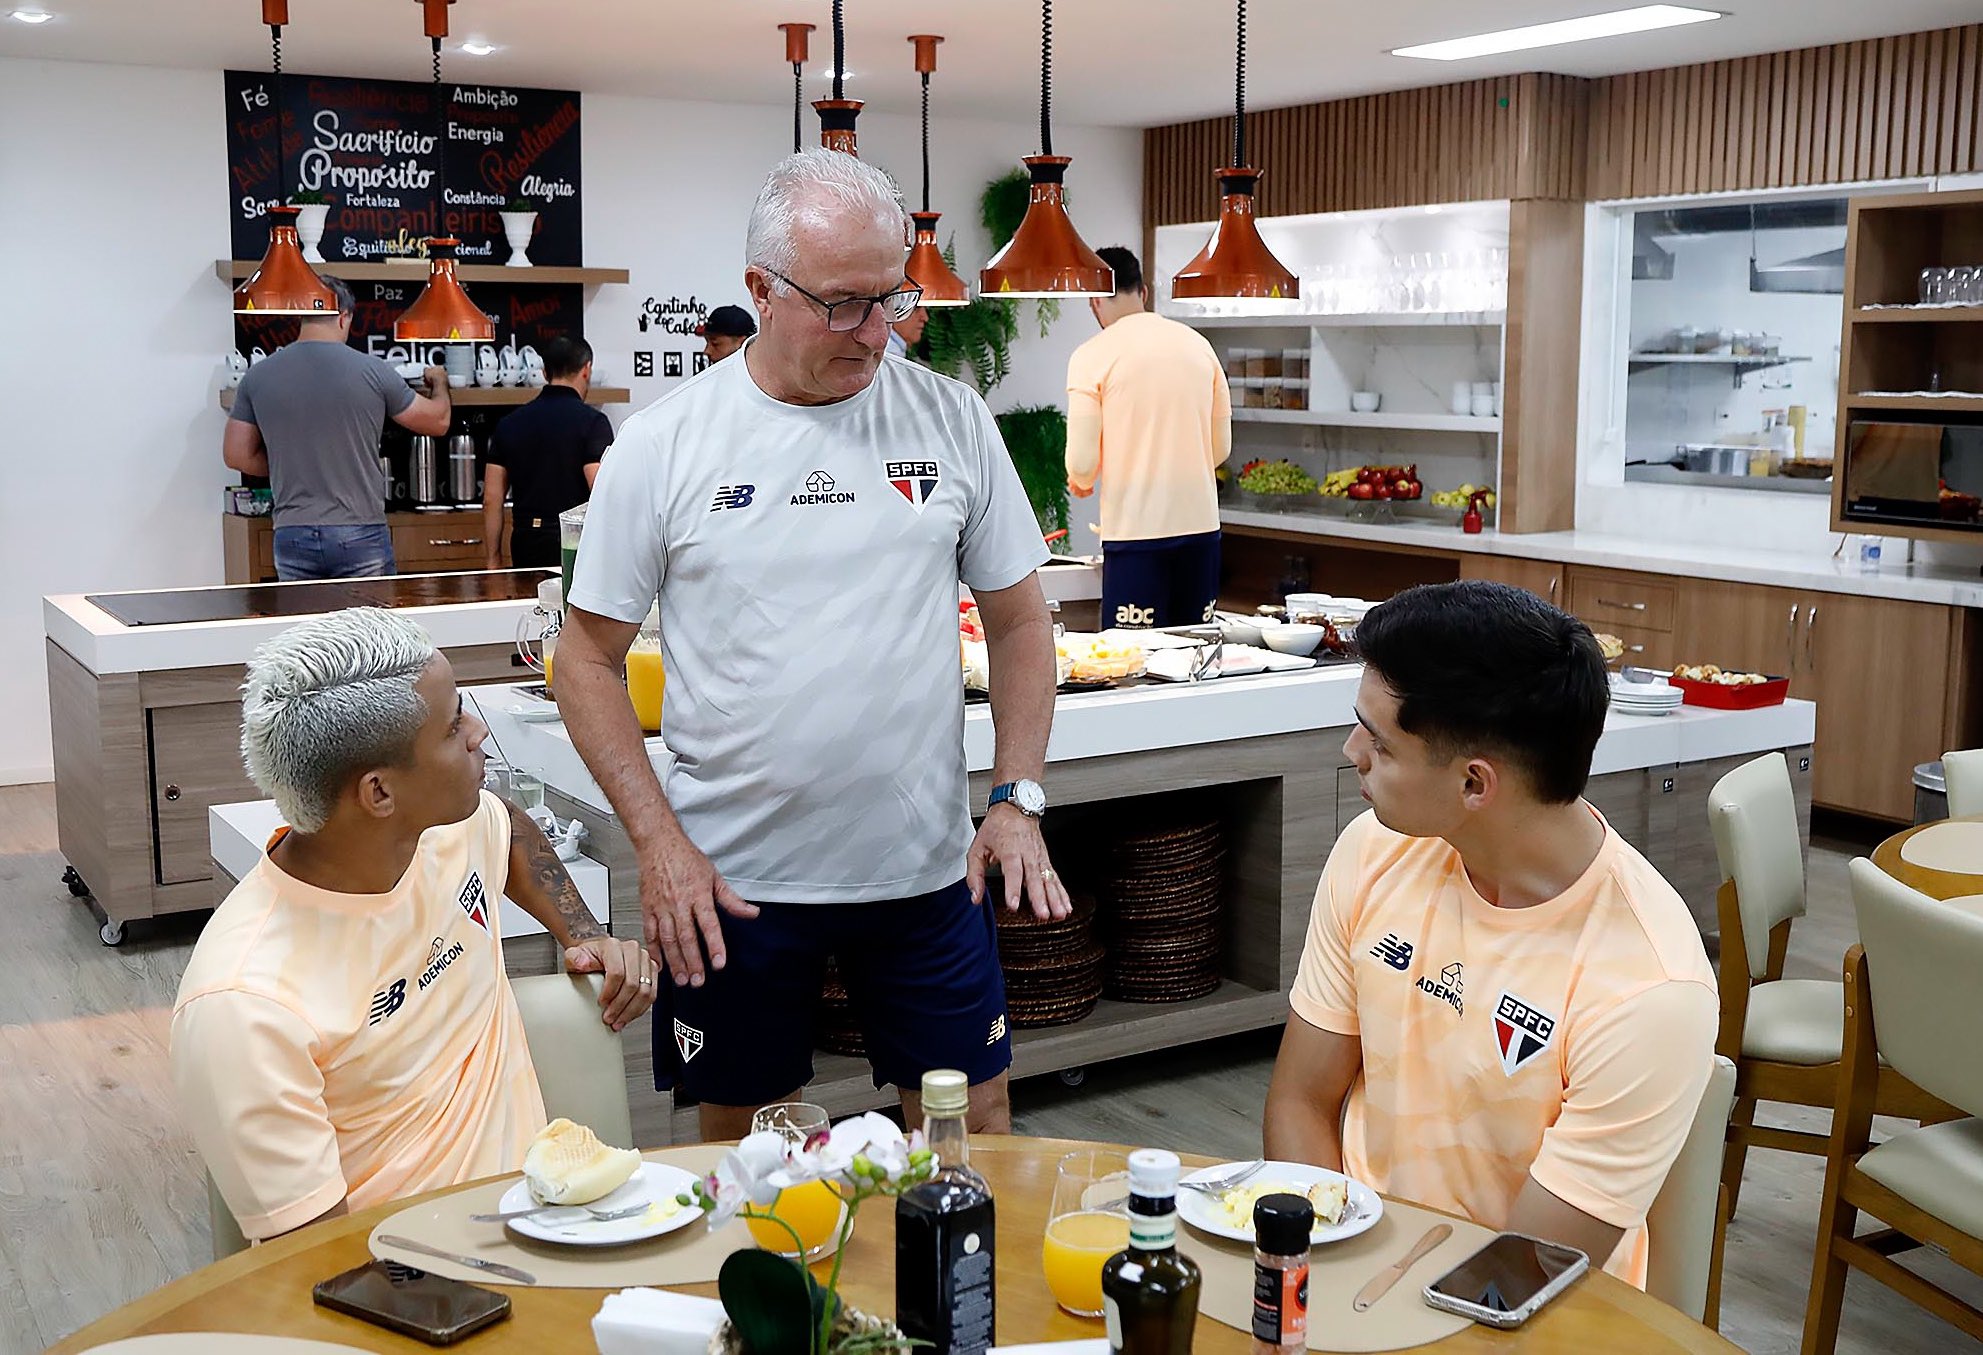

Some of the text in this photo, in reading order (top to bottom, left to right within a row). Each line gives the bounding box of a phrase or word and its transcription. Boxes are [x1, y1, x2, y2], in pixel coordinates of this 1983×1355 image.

[240, 84, 270, 112] Fé
[452, 86, 519, 110] Ambição
[313, 109, 438, 157] Sacrifício
[447, 121, 505, 145] Energia
[298, 147, 436, 195] Propósito
[444, 187, 506, 206] Constância
[520, 174, 576, 203] Alegria
[346, 193, 401, 209] Fortaleza
[374, 283, 404, 301] Paz
[888, 462, 938, 477] SPFC
[790, 492, 855, 506] ADEMICON
[1115, 603, 1155, 625] abc
[461, 873, 483, 911] SPFC
[418, 941, 465, 991] ADEMICON
[1415, 975, 1464, 1018] ADEMIC
[1499, 997, 1553, 1038] SPFC
[675, 1022, 702, 1043] SPFC
